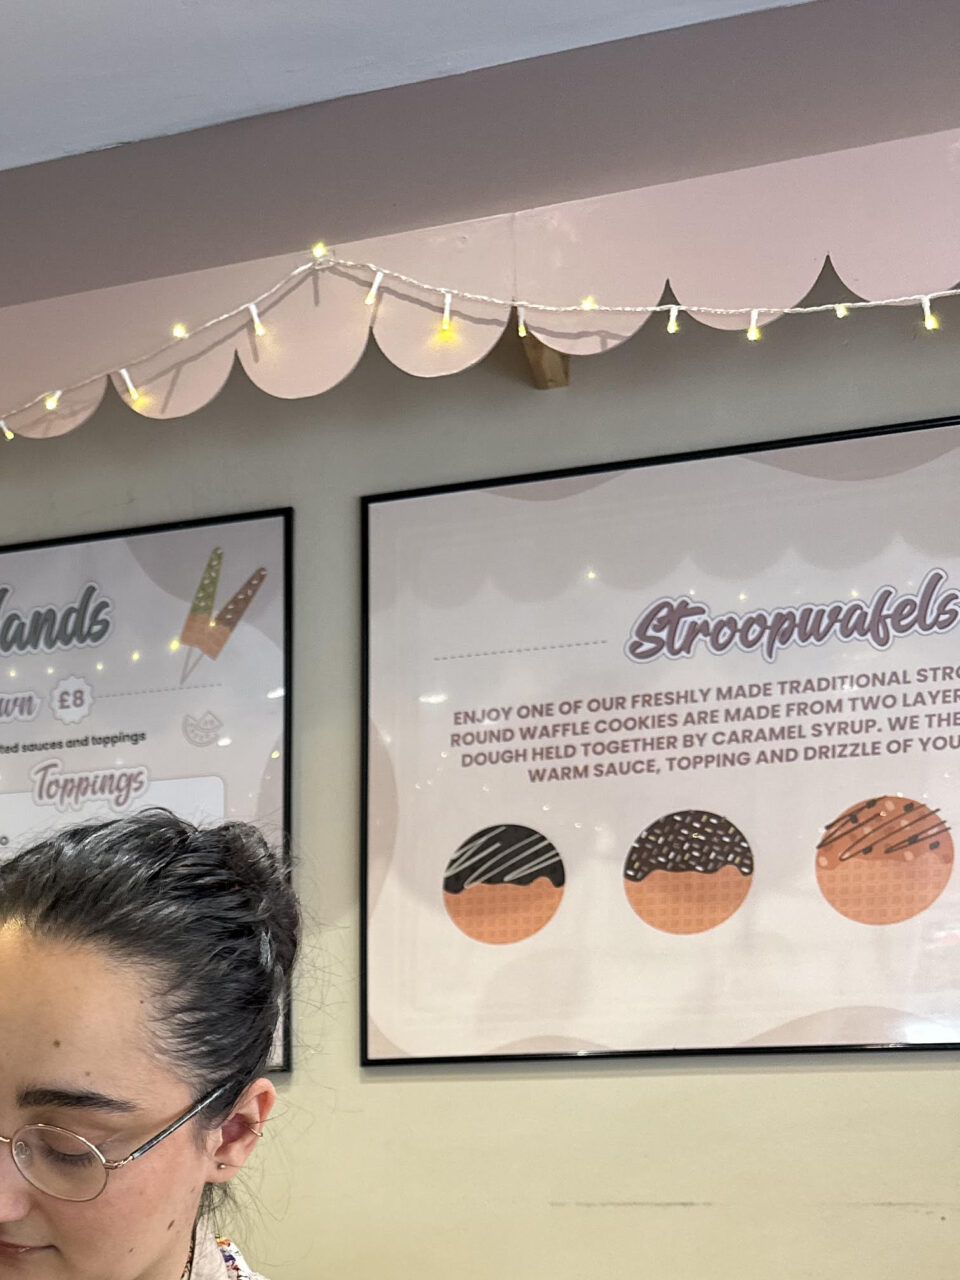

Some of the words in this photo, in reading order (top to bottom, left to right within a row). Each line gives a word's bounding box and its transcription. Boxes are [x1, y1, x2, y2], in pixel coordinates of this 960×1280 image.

[628, 572, 960, 660] Stroopwafels
[58, 688, 85, 710] £8
[450, 728, 515, 747] ROUND
[519, 722, 590, 740] WAFFLE
[594, 714, 678, 733] COOKIES
[682, 710, 719, 726] ARE
[724, 704, 781, 722] MADE
[786, 700, 843, 717] FROM
[848, 694, 897, 712] TWO
[454, 707, 512, 725] ENJOY
[516, 703, 554, 719] ONE
[559, 700, 583, 715] OF
[587, 696, 627, 713] OUR
[631, 688, 711, 709] FRESHLY
[716, 683, 772, 700] MADE
[778, 670, 911, 695] TRADITIONAL
[21, 739, 63, 752] sauces
[65, 735, 89, 749] and
[91, 730, 146, 748] toppings
[462, 748, 527, 768] DOUGH
[532, 744, 576, 761] HELD
[580, 737, 678, 756] TOGETHER
[682, 733, 708, 748] BY
[712, 724, 806, 745] CARAMEL
[811, 719, 882, 738] SYRUP.
[888, 715, 920, 731] WE
[528, 766, 589, 783] WARM
[593, 759, 661, 776] SAUCE,
[666, 752, 751, 771] TOPPING
[756, 748, 798, 765] AND
[804, 742, 881, 760] DRIZZLE
[886, 739, 913, 754] OF
[34, 762, 145, 806] Toppings
